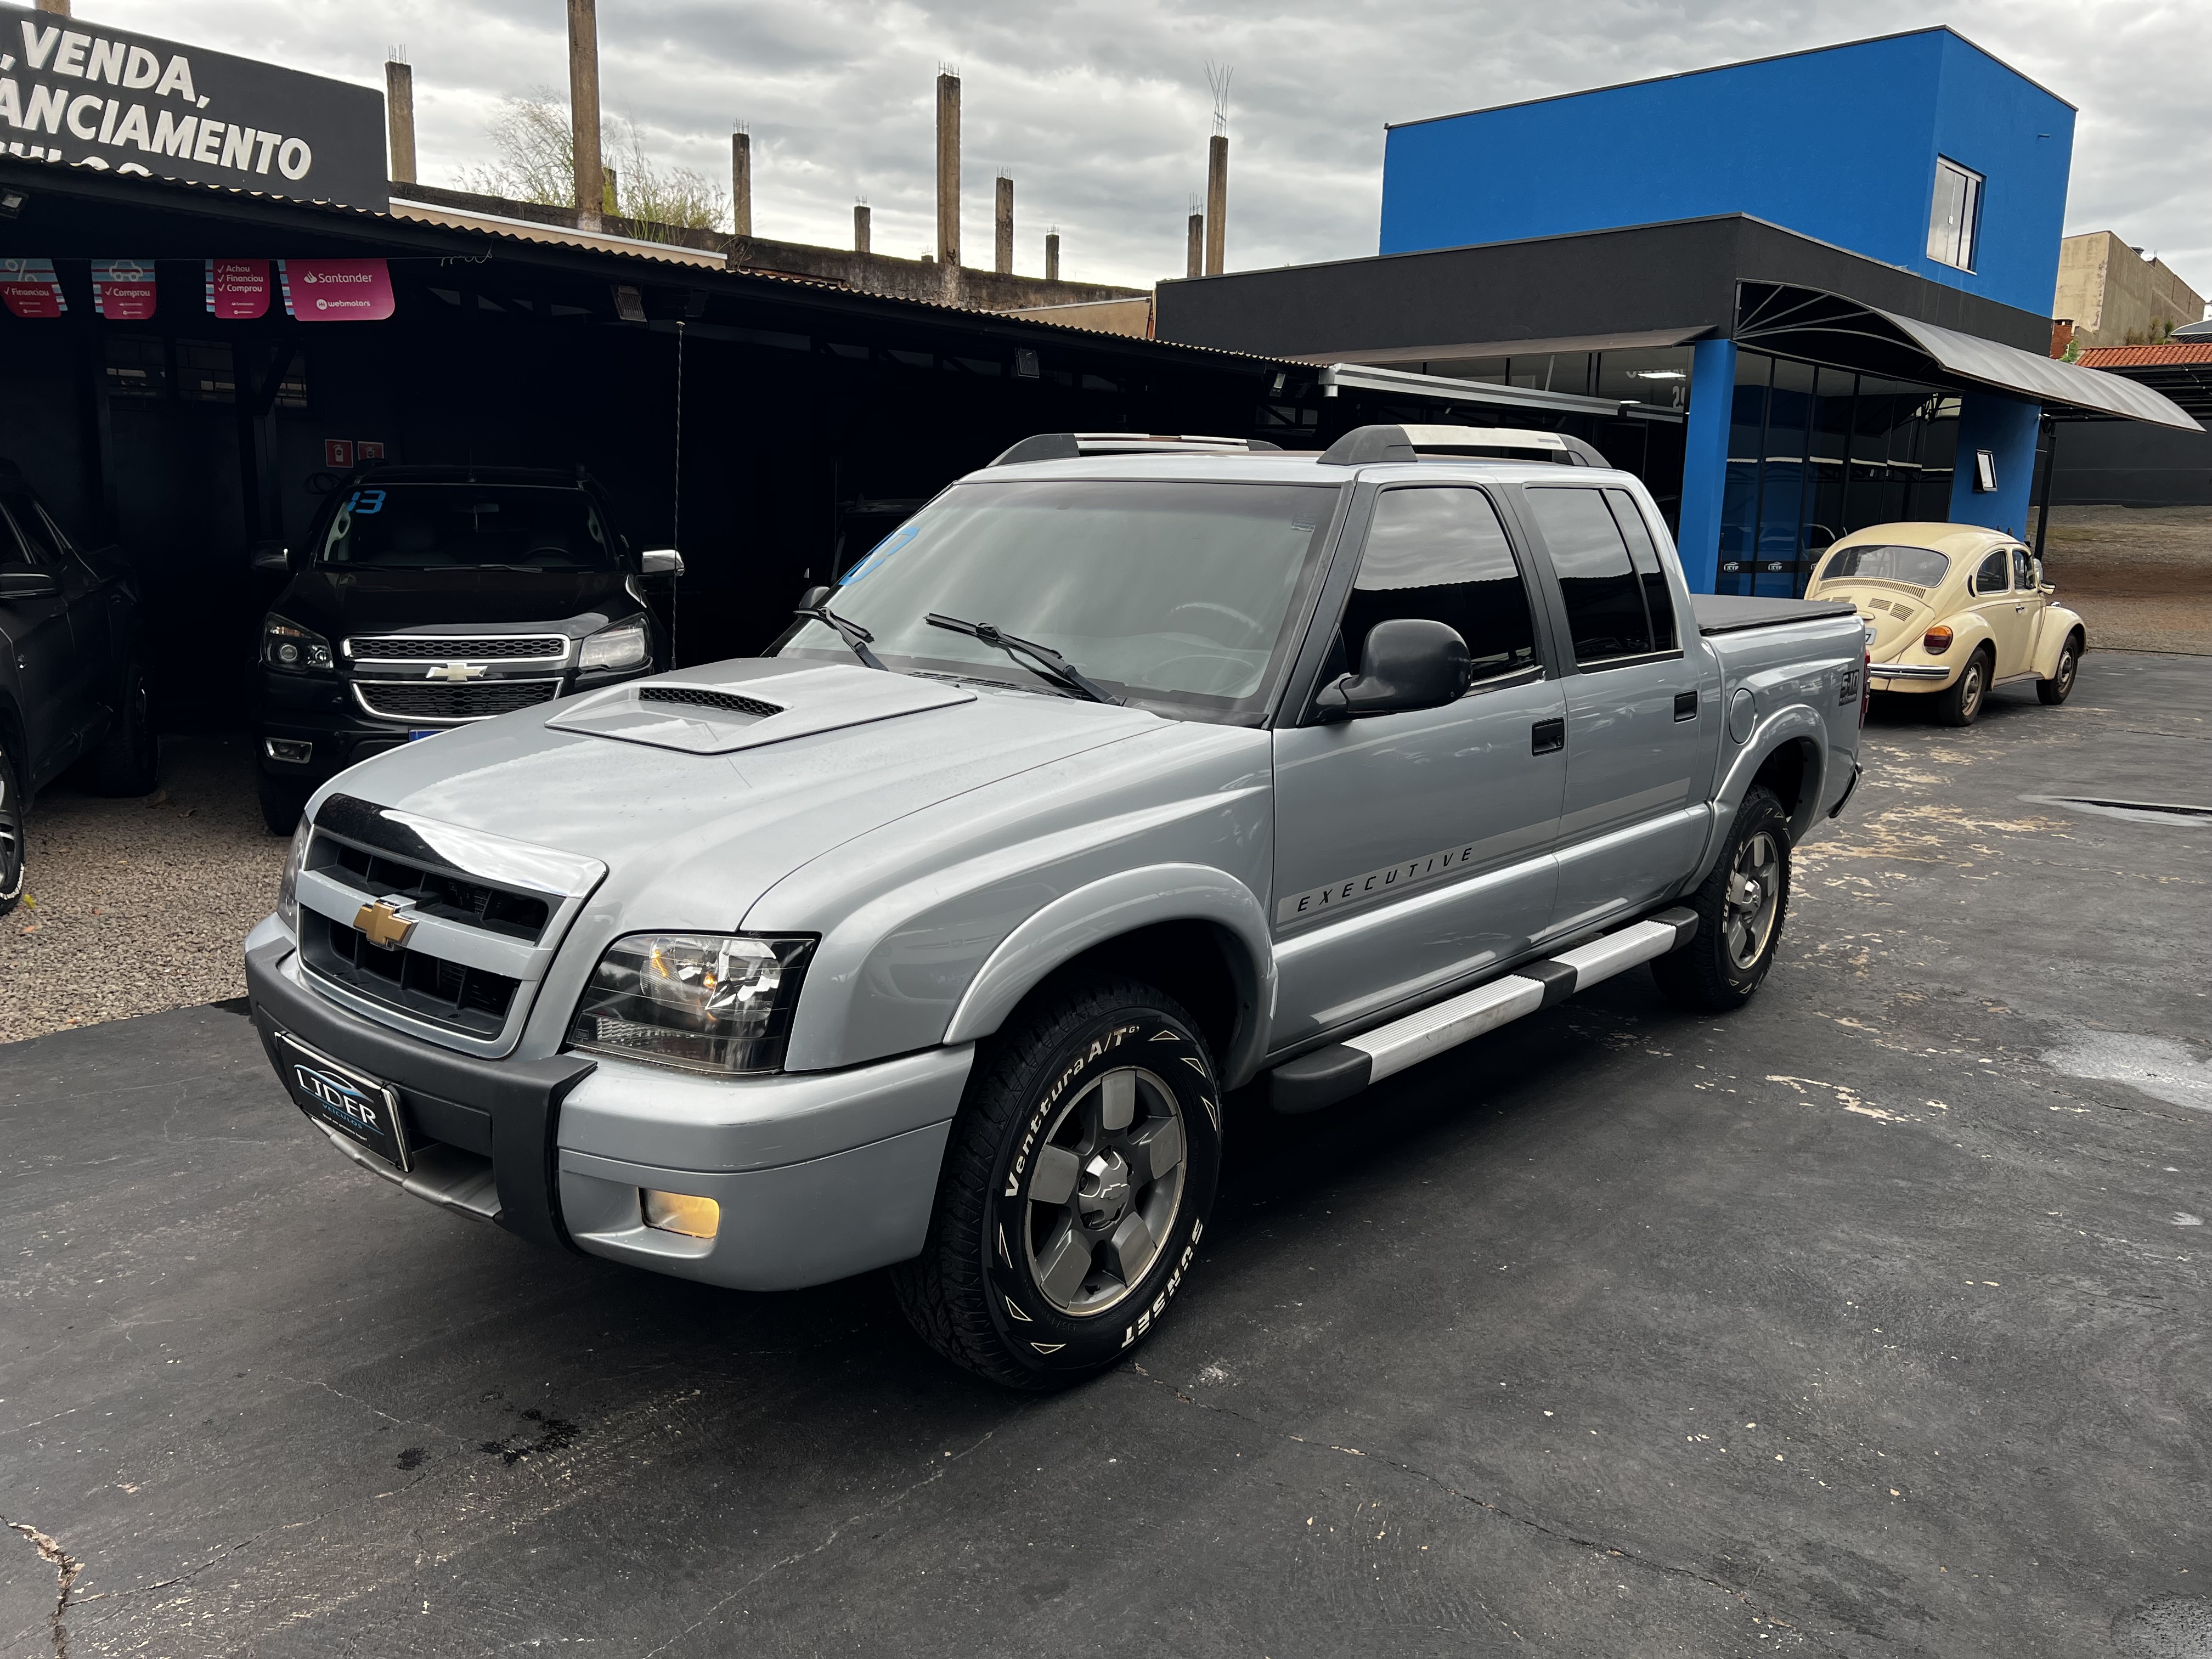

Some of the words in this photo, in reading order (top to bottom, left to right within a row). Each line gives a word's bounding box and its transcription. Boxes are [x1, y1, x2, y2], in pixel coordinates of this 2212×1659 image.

[20, 20, 210, 109] VENDA,
[0, 77, 312, 180] ANCIAMENTO
[226, 274, 264, 283] Financiou
[227, 284, 262, 294] Comprou
[319, 273, 373, 283] Santander
[12, 287, 50, 296] Financiou
[113, 288, 150, 299] Comprou
[346, 490, 386, 514] 13
[1297, 847, 1472, 912] EXECUTIVE
[1005, 1057, 1084, 1197] Venttura
[1121, 1217, 1204, 1348] SUNSET
